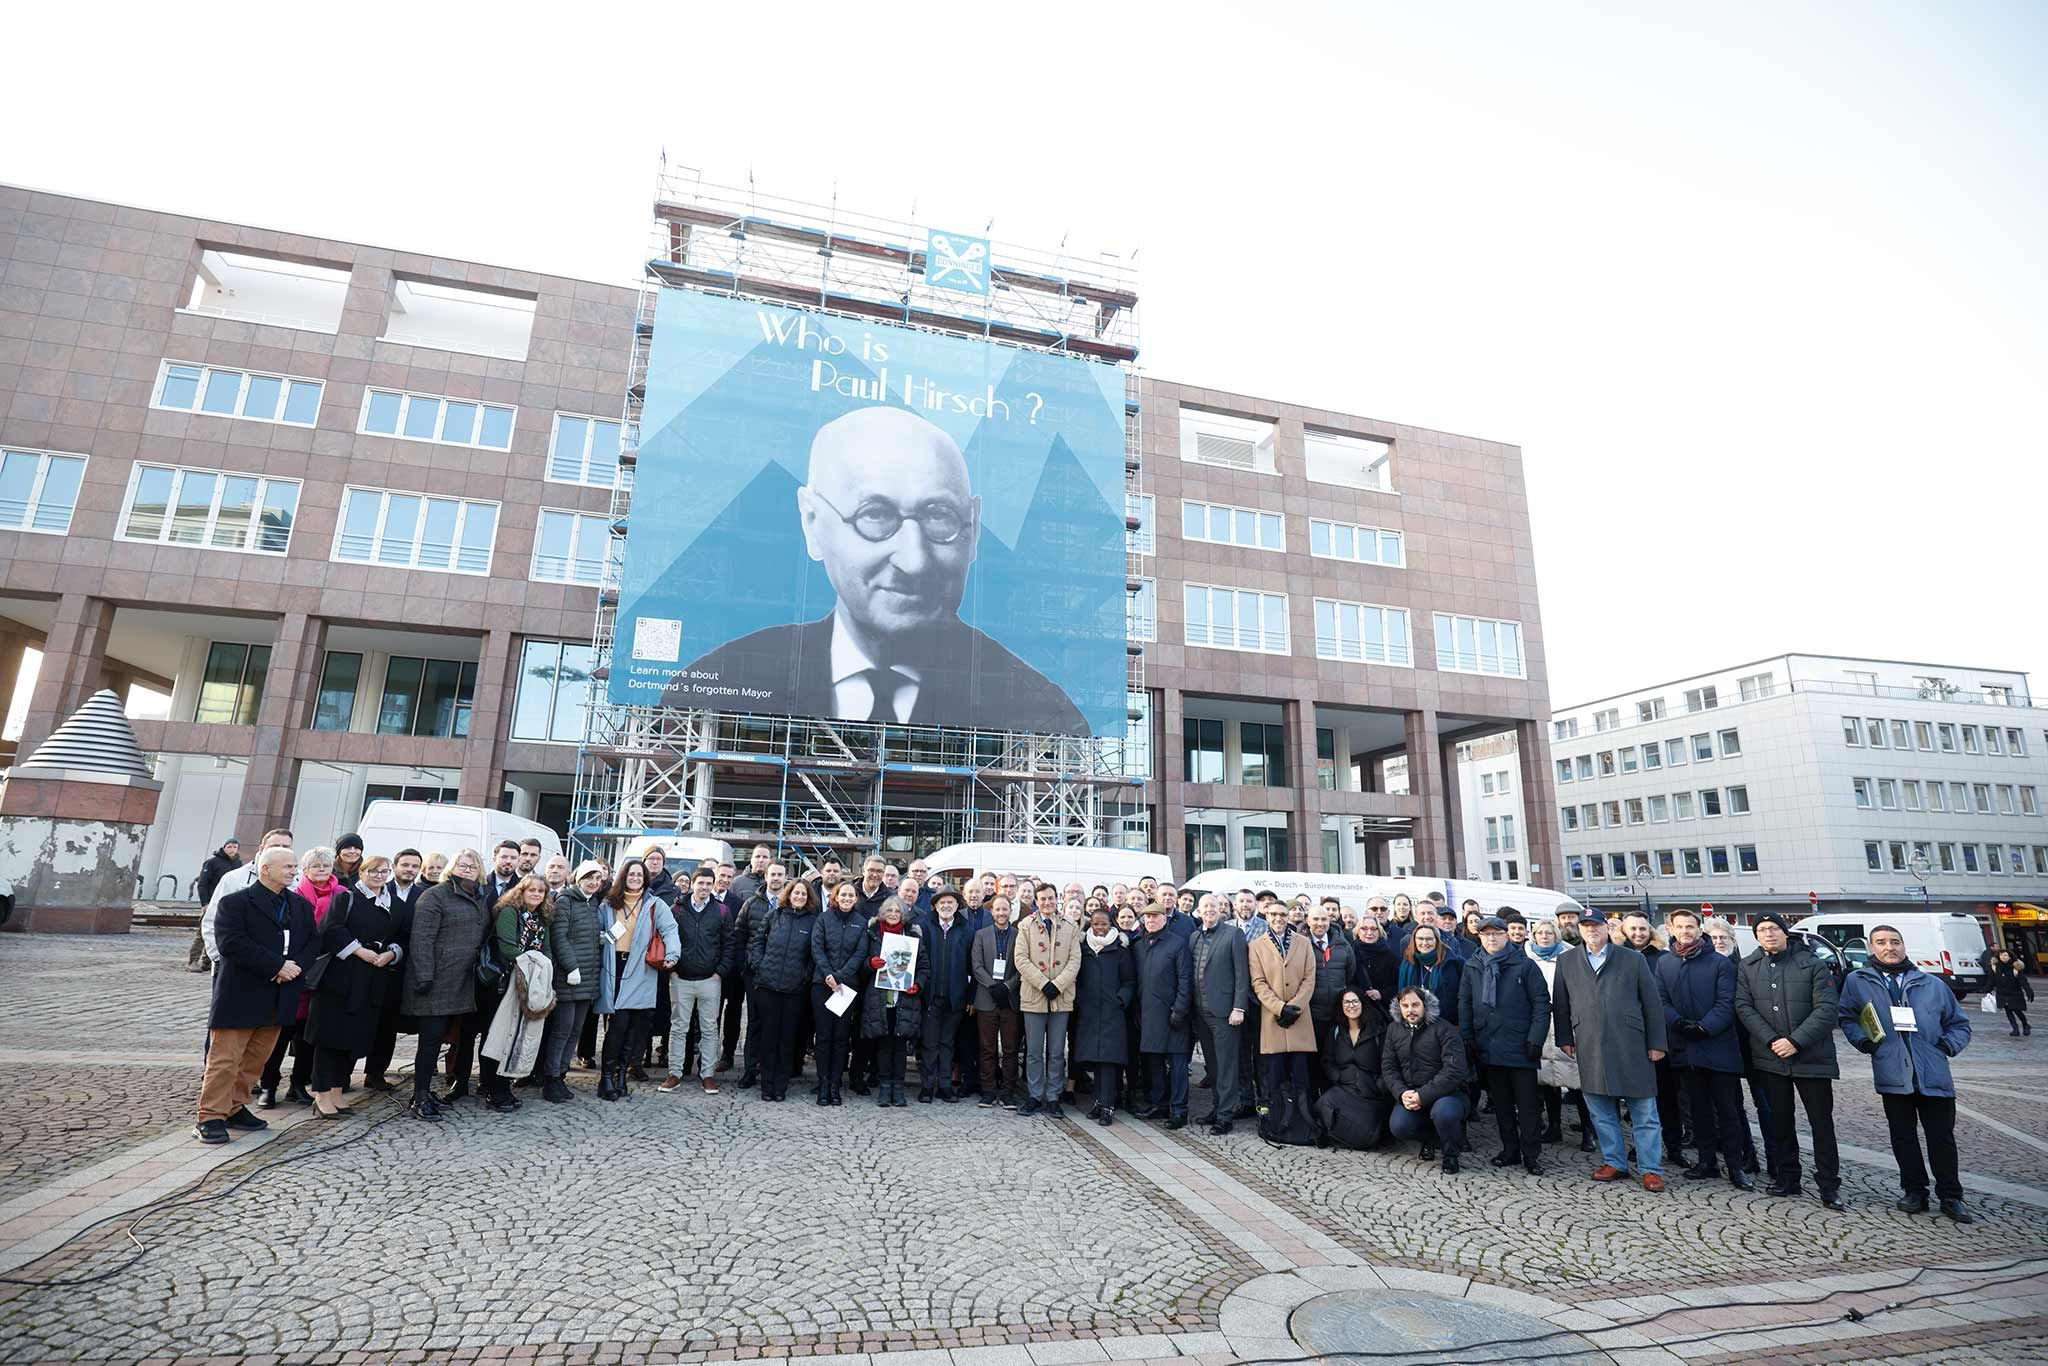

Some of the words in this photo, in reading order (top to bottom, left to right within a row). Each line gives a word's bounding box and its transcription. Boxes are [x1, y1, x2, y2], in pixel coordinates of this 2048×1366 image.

[757, 311, 845, 355] Who
[863, 332, 889, 362] is
[811, 359, 887, 401] Paul
[904, 374, 1009, 420] Hirsch
[1025, 392, 1044, 424] ?
[630, 665, 659, 676] Learn
[662, 668, 688, 678] more
[690, 670, 719, 680] about
[692, 683, 739, 696] forgotten
[741, 687, 773, 699] Mayor
[1274, 880, 1298, 889] Dusch
